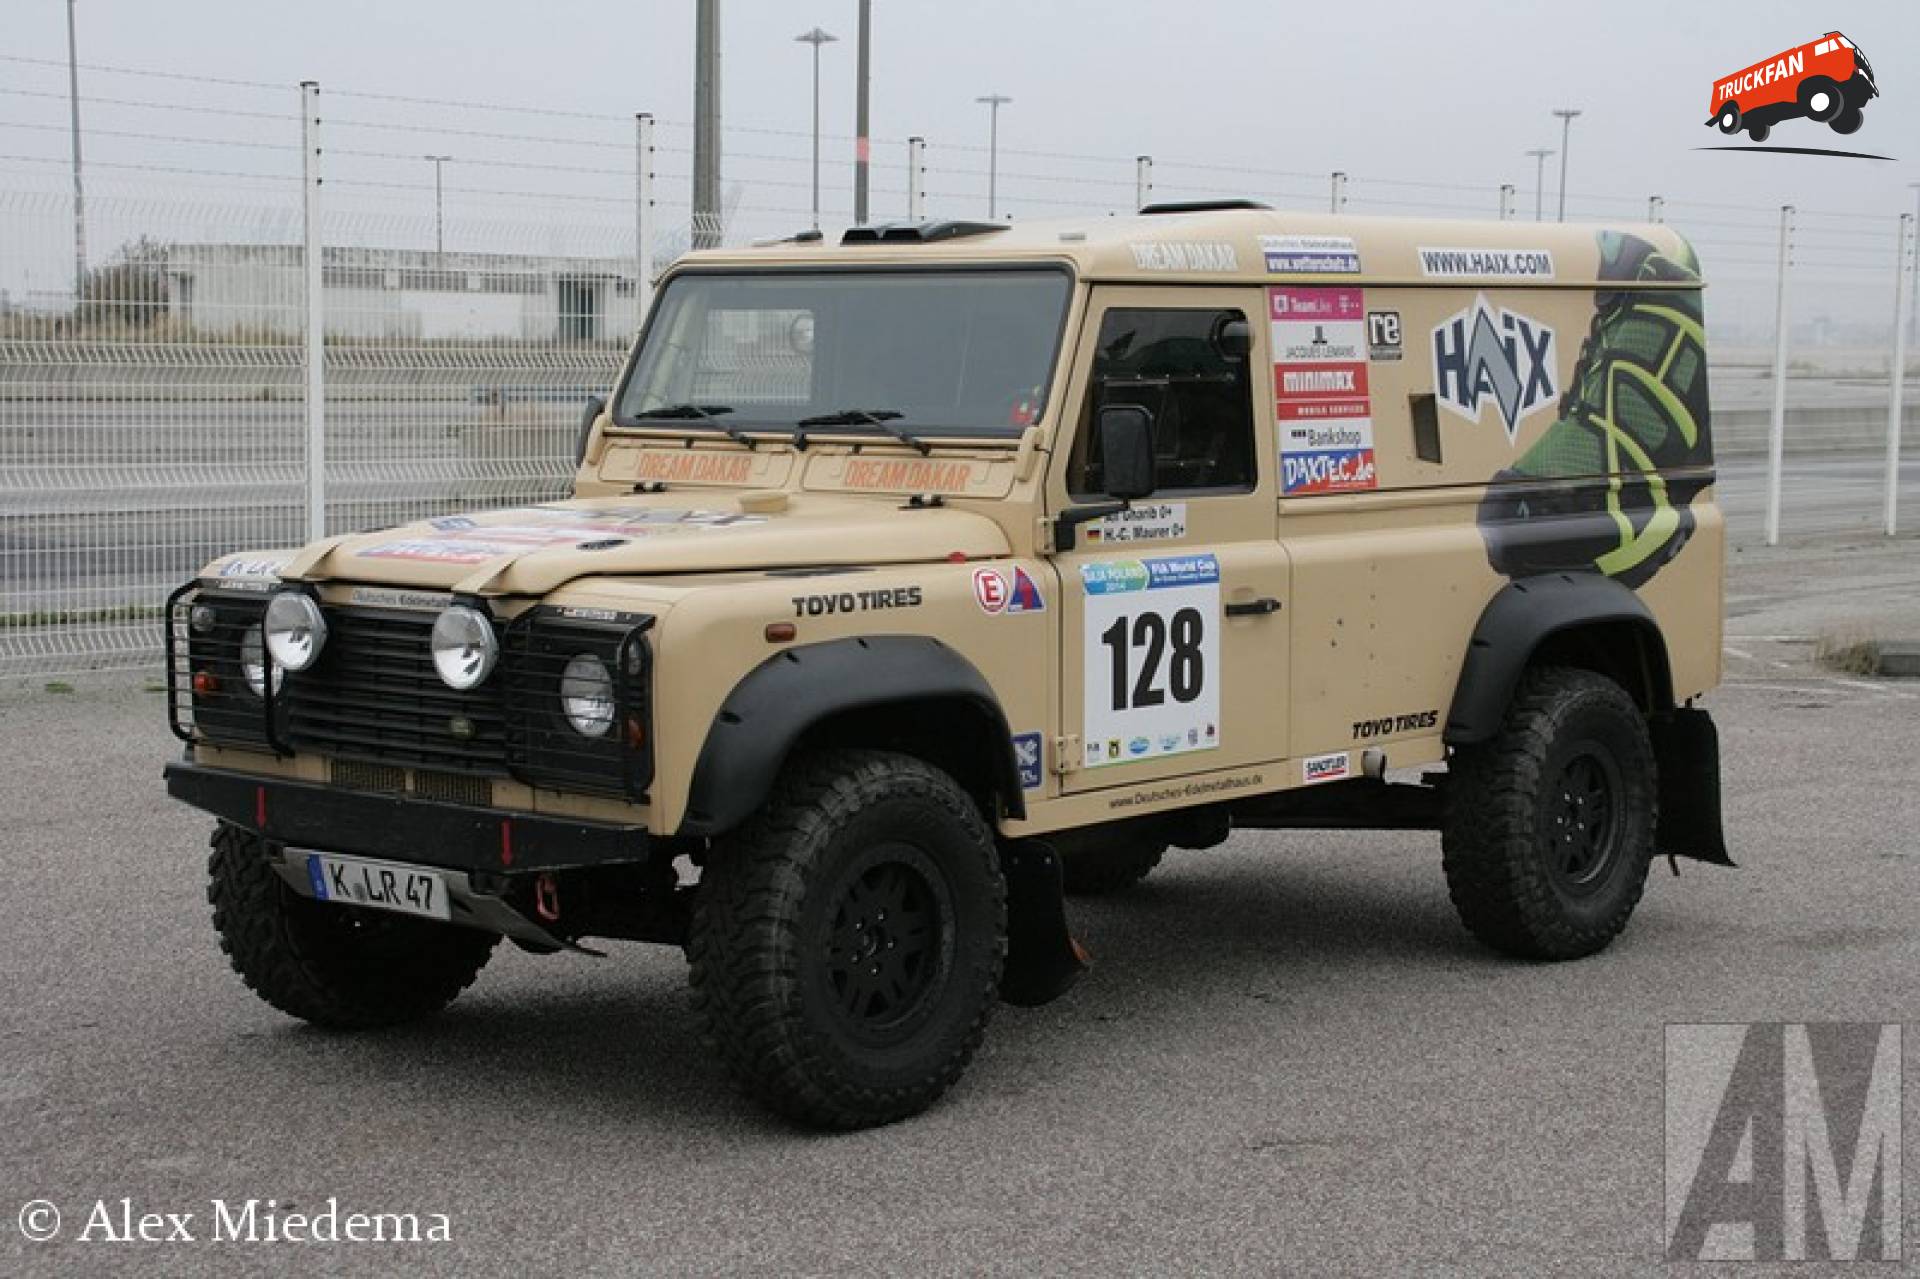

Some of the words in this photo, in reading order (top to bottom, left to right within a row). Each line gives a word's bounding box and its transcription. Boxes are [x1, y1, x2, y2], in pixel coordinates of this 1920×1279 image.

[1422, 251, 1551, 275] WWW.HAIX.COM
[1308, 427, 1361, 449] Bankshop
[639, 453, 692, 479] DREAM
[697, 454, 752, 481] DAKAR
[844, 459, 903, 489] DREAM
[906, 461, 971, 492] DAKAR
[1132, 524, 1170, 539] Maurer
[792, 593, 855, 617] TOYO
[857, 586, 922, 611] TIRES
[980, 575, 1001, 603] E
[1101, 606, 1203, 711] 128
[1352, 717, 1393, 740] TOYO
[1396, 710, 1439, 732] TIRES
[329, 863, 352, 898] K
[362, 867, 402, 905] LR
[405, 872, 433, 910] 47
